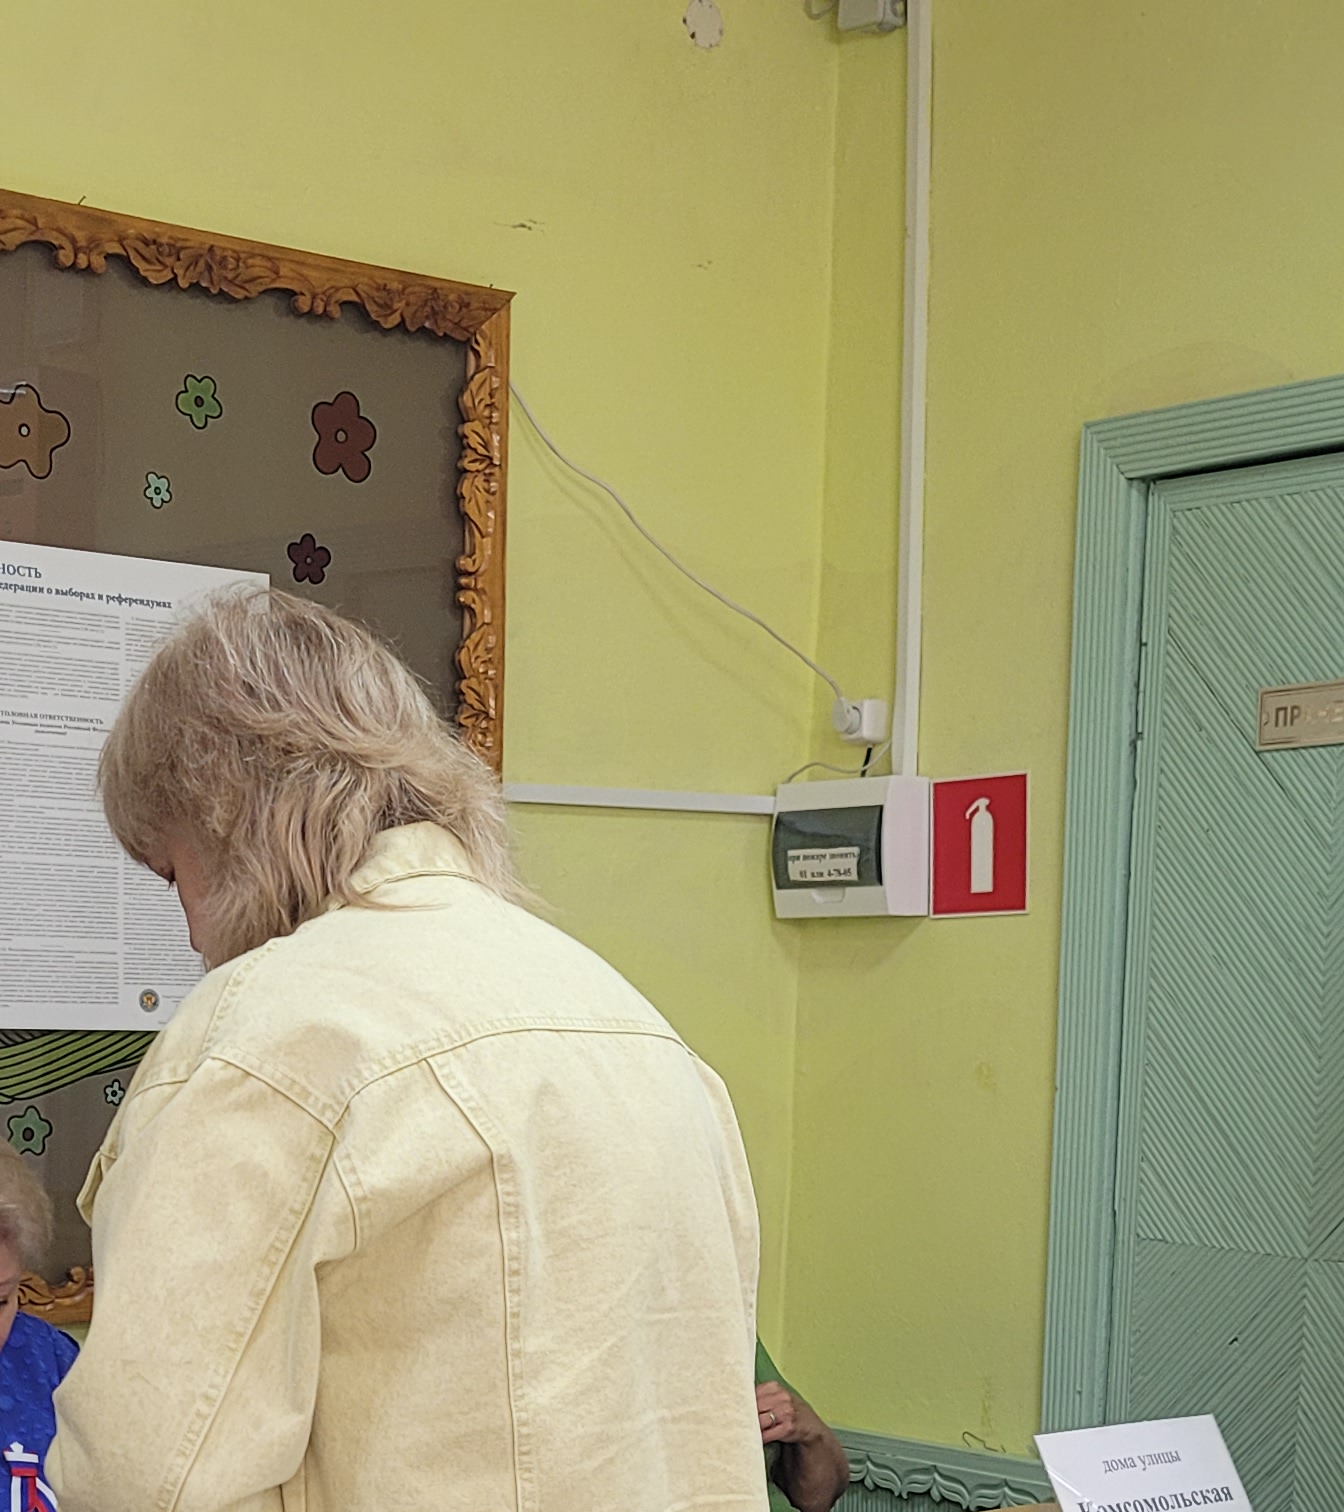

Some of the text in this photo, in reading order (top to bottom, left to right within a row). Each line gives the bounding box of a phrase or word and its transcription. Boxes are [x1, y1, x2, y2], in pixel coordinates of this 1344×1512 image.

[55, 587, 95, 601] выборах
[105, 593, 172, 609] референдумах
[1102, 1450, 1182, 1474] дома улицы
